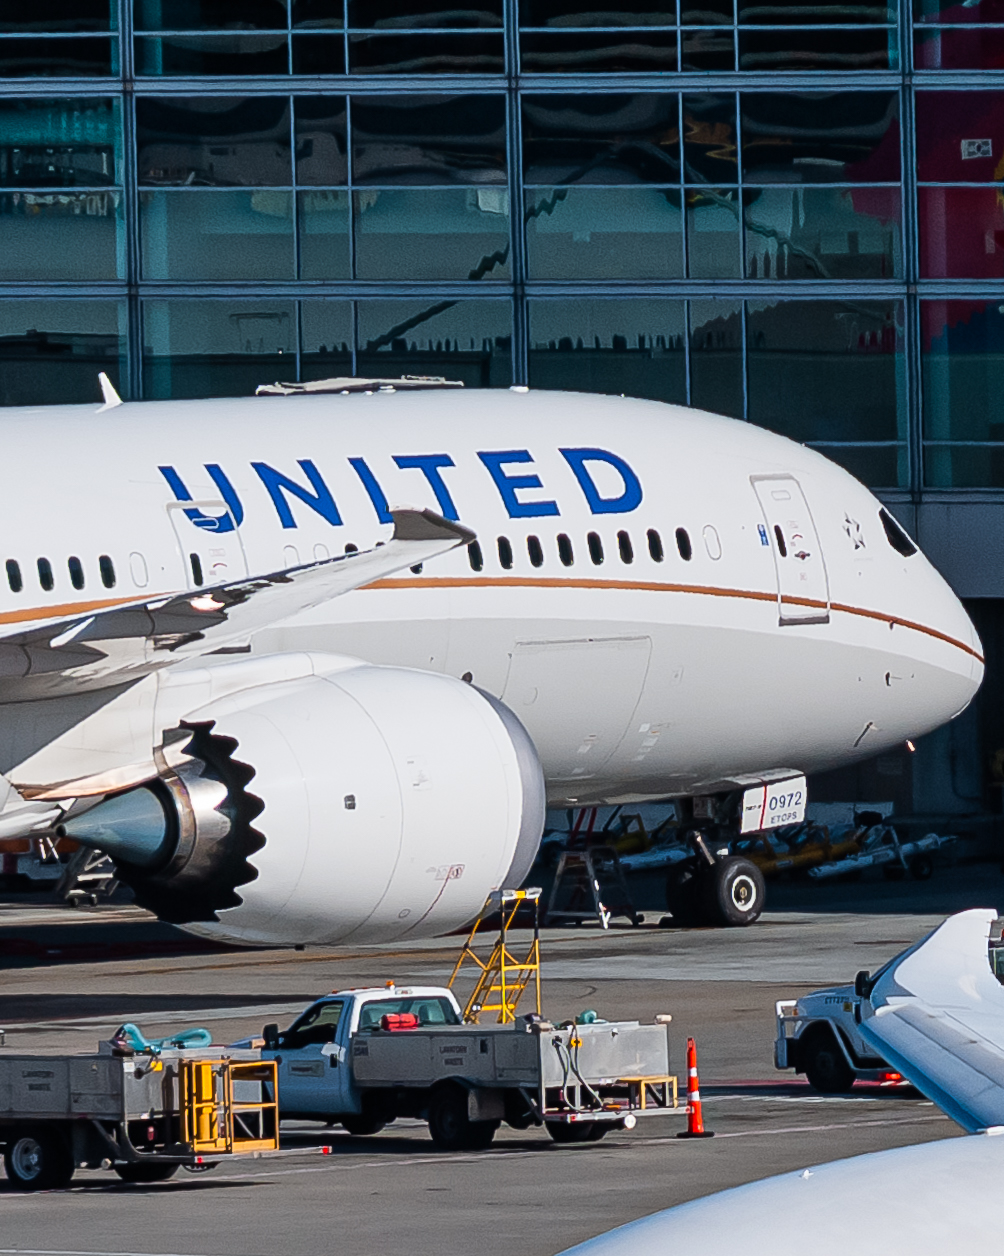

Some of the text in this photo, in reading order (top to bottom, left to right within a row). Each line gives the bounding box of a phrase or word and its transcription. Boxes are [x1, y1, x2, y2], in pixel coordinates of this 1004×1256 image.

[157, 448, 643, 533] UNITED
[768, 791, 802, 811] 0972
[770, 811, 798, 824] ETOPS
